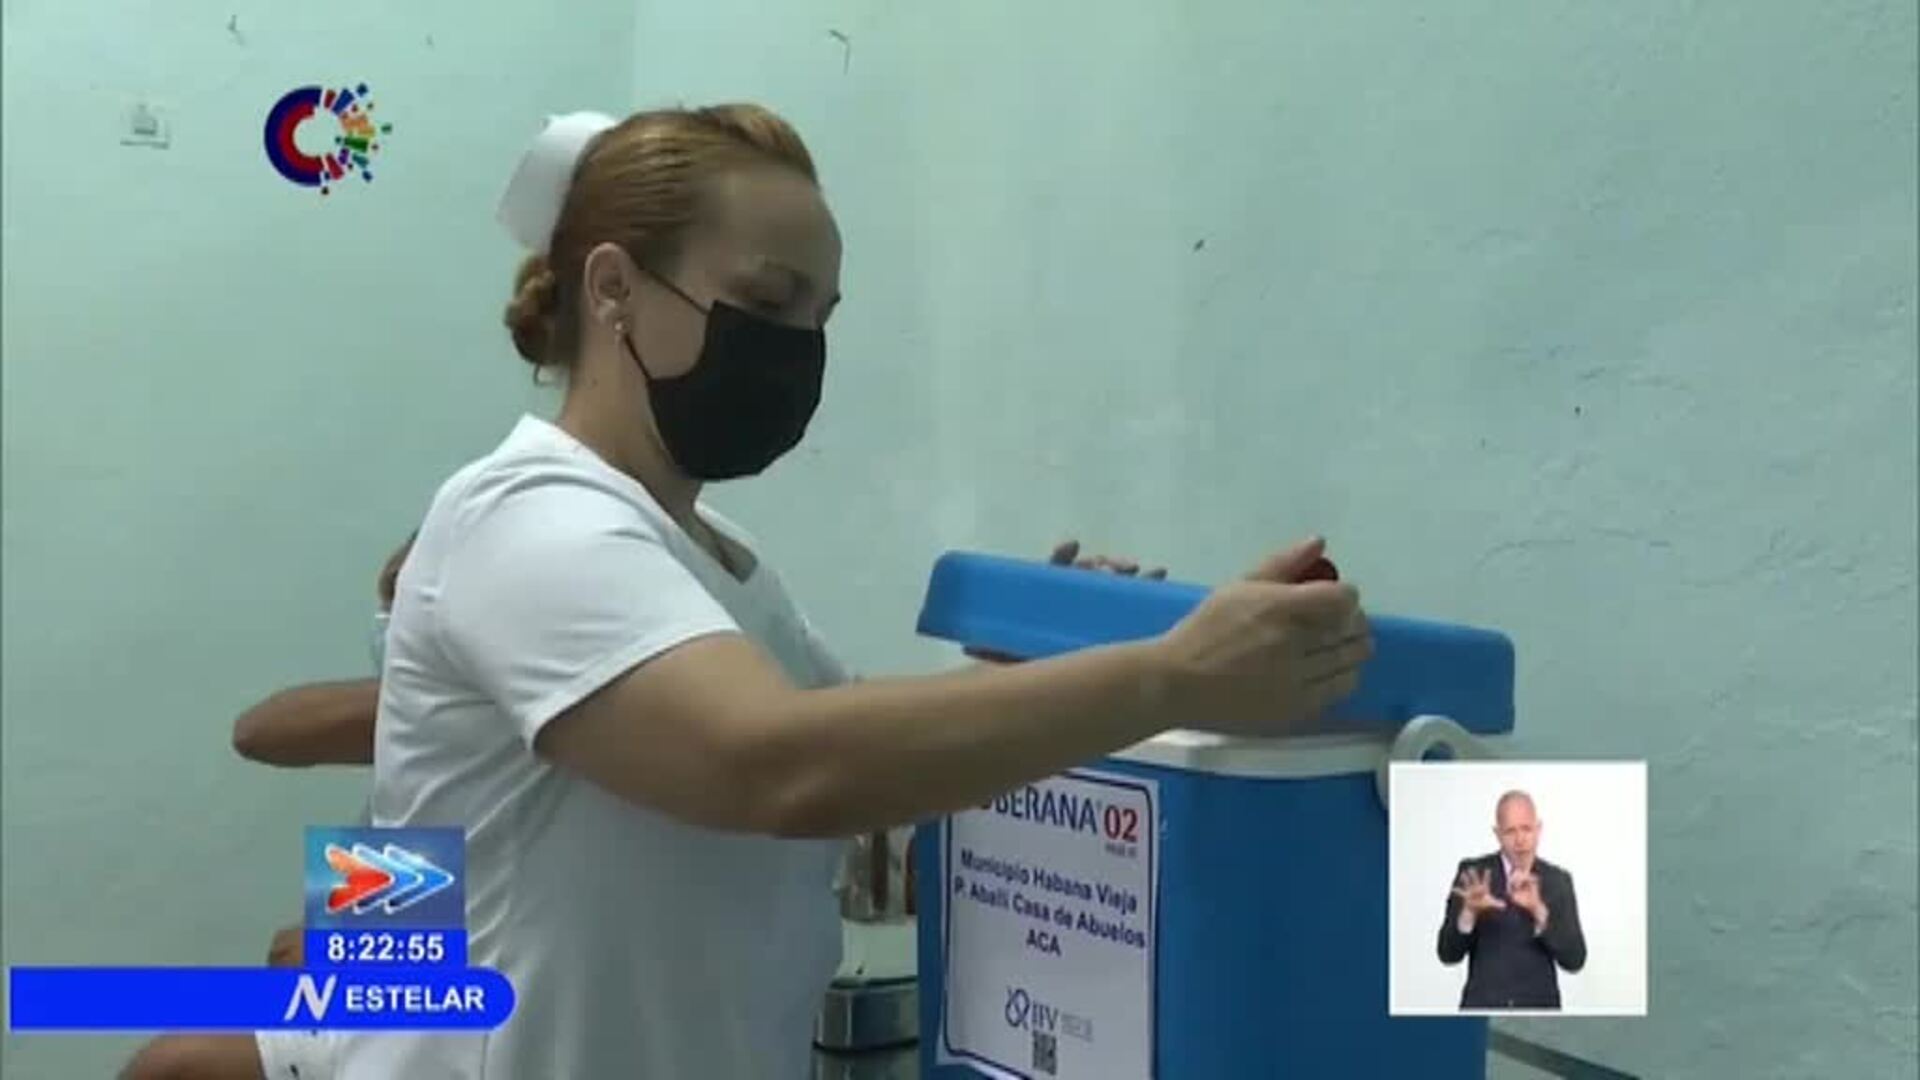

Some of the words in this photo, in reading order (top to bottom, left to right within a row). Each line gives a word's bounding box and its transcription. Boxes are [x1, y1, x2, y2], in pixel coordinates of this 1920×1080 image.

[1104, 805, 1138, 843] 02
[961, 848, 1030, 885] Municipio
[1033, 868, 1092, 901] Habana
[1096, 883, 1137, 916] Vieja
[1012, 892, 1050, 922] Casa
[1053, 904, 1073, 930] de
[1076, 911, 1146, 949] Abuelos
[1026, 928, 1061, 956] ACA
